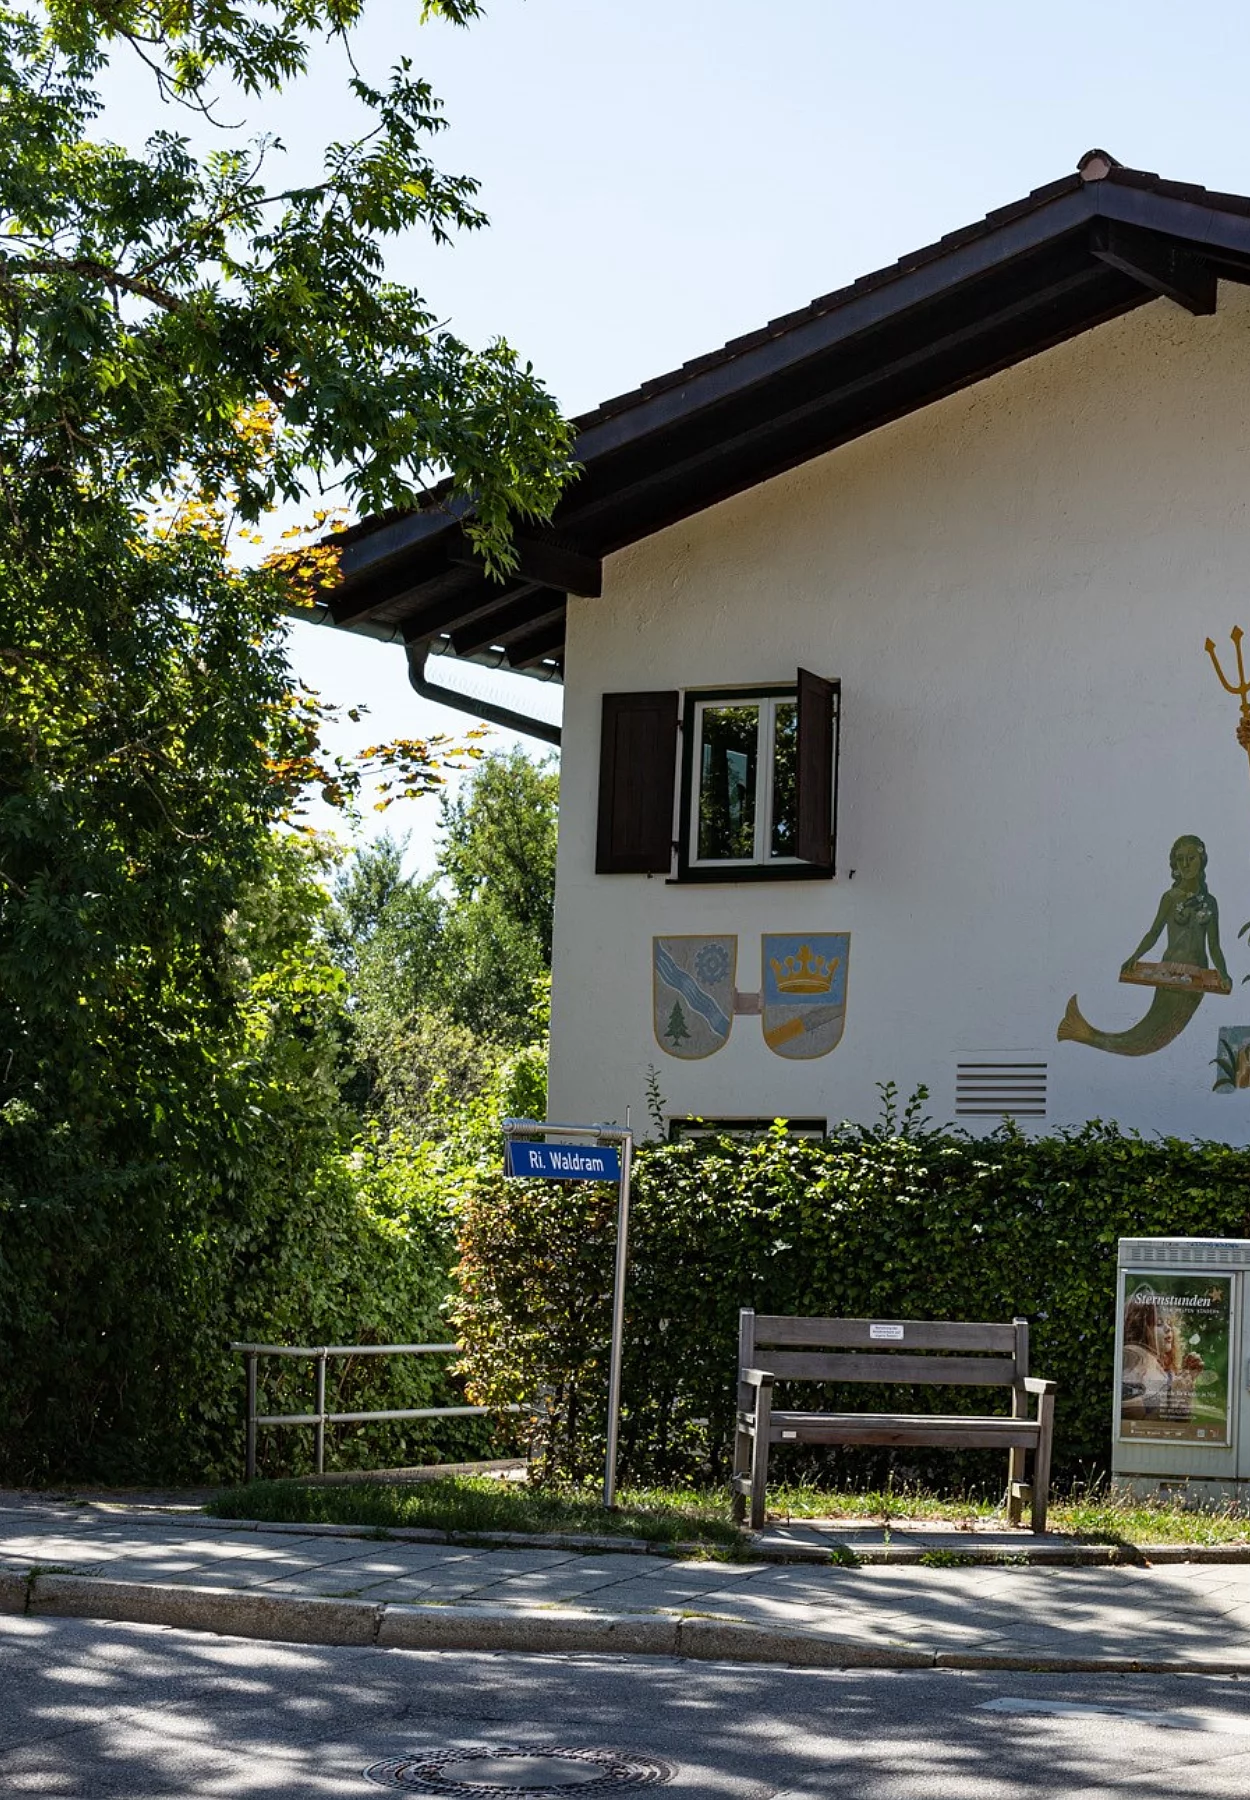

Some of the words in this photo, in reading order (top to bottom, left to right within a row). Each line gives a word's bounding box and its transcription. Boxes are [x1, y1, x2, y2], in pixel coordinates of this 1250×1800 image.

[529, 1150, 546, 1169] Ri.
[549, 1151, 604, 1172] Waldram
[1134, 1292, 1211, 1307] Sternstunden
